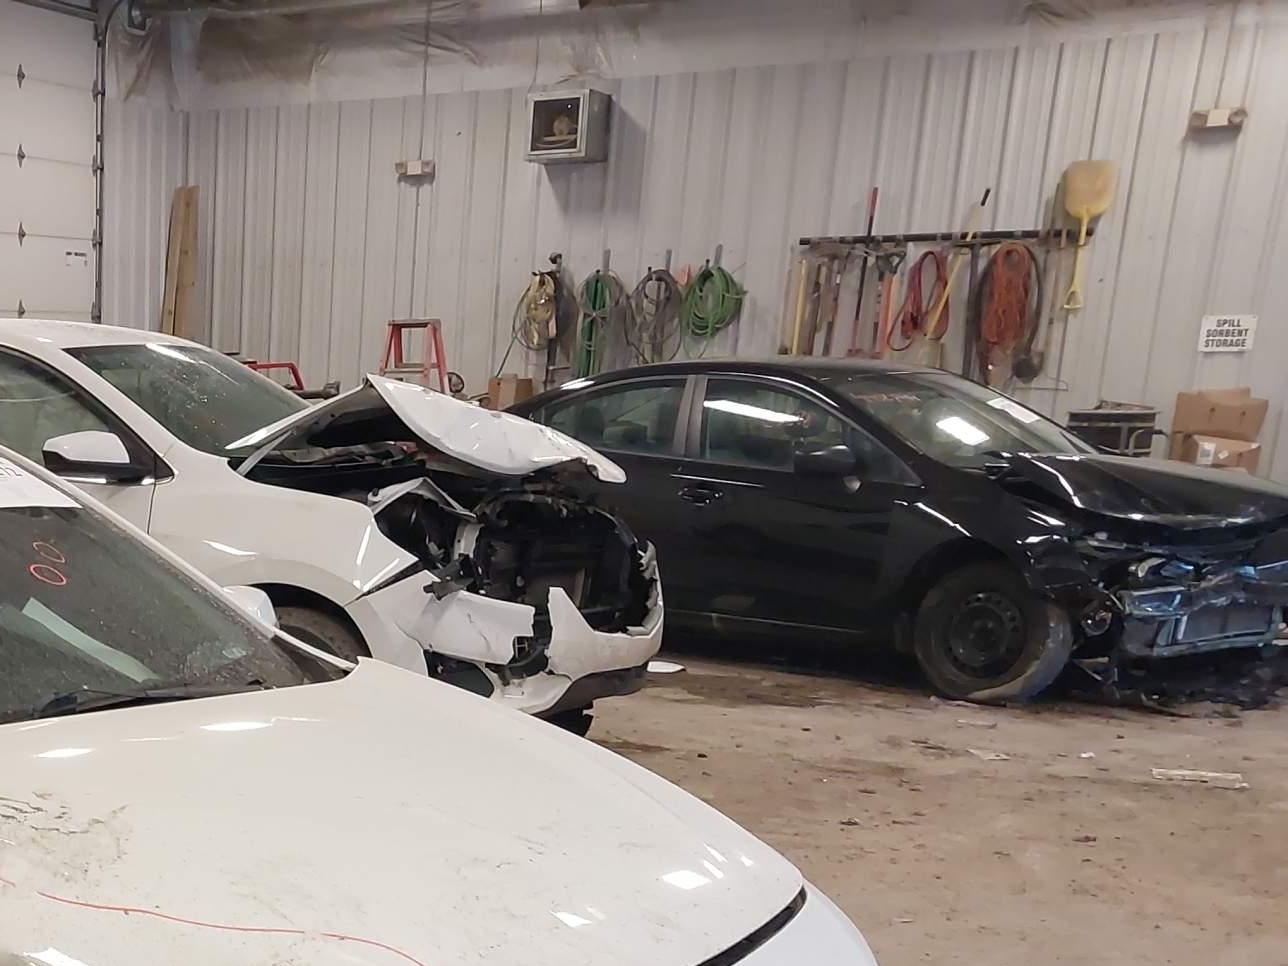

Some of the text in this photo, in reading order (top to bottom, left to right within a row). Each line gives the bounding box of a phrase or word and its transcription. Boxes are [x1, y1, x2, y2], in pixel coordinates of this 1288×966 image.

[1215, 318, 1242, 328] SPILL
[1205, 328, 1250, 338] SORBENT
[1204, 338, 1248, 348] STORAGE
